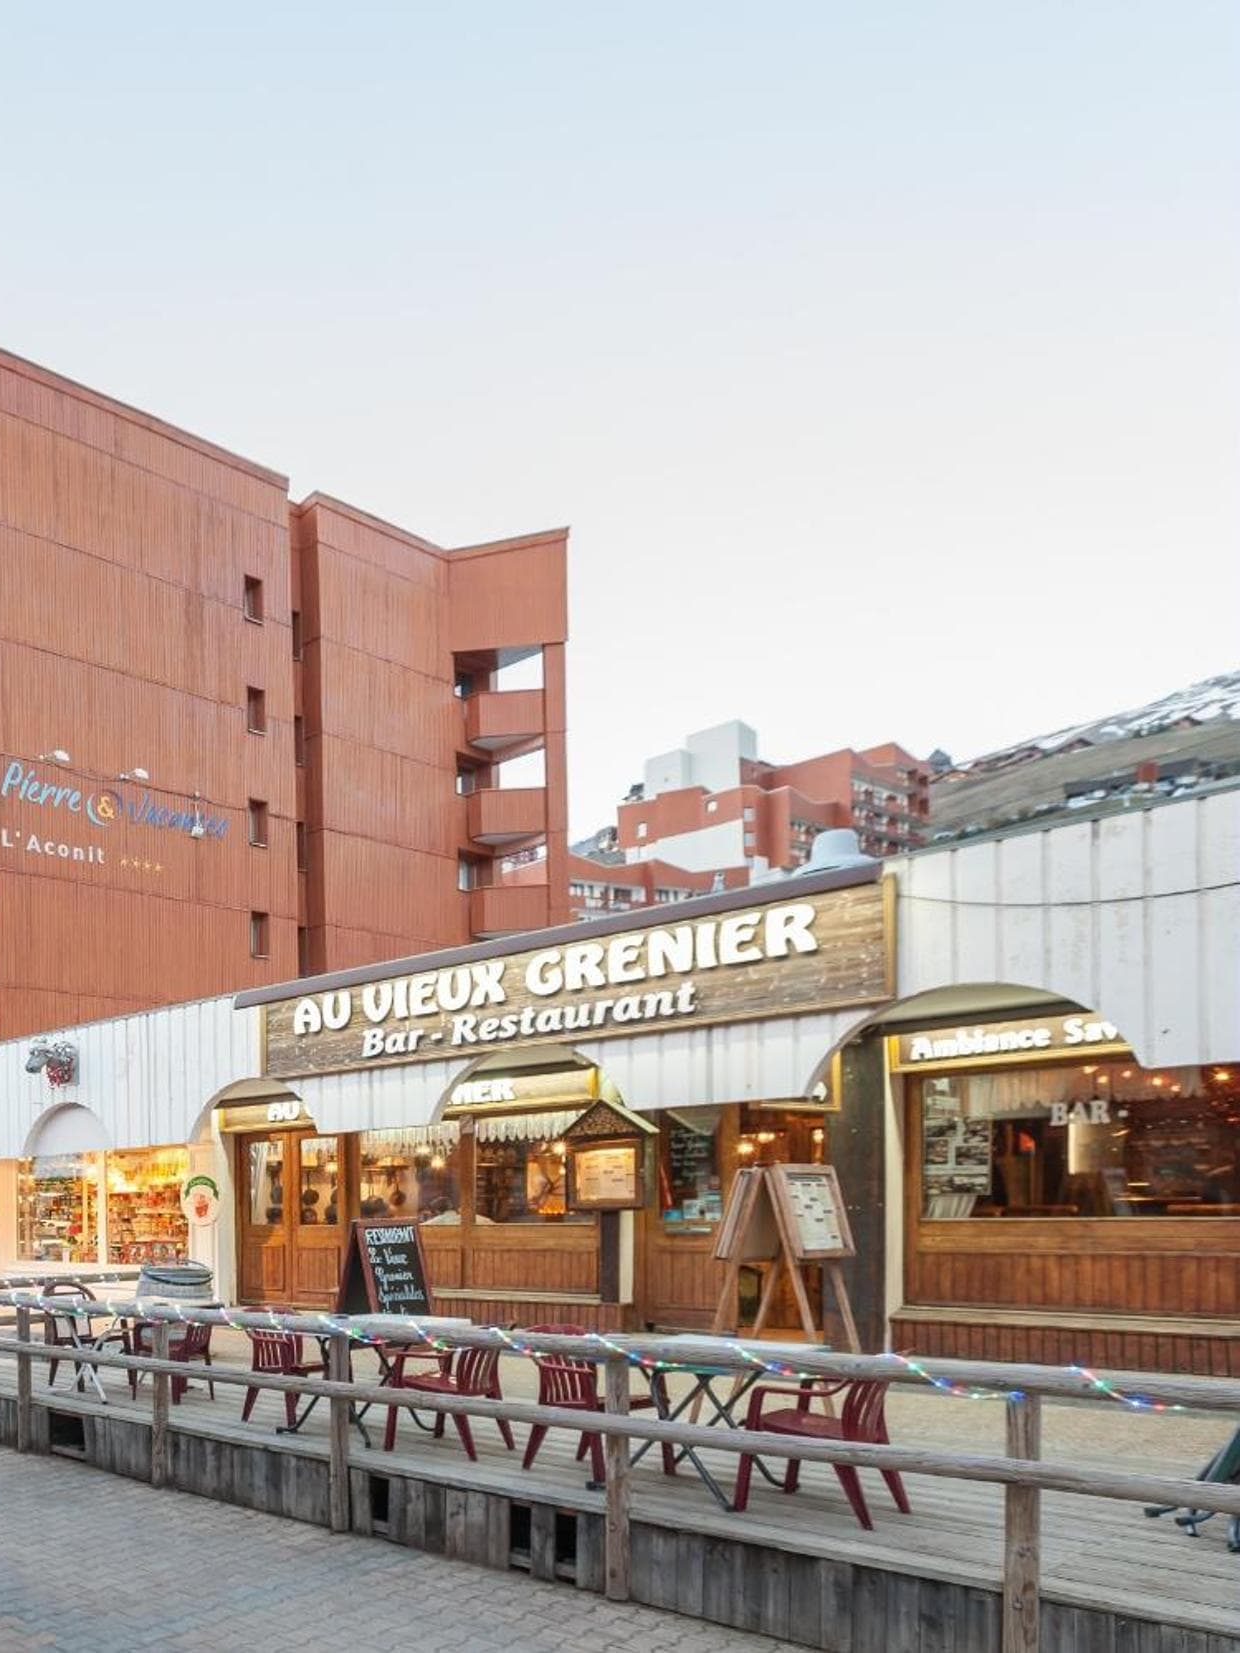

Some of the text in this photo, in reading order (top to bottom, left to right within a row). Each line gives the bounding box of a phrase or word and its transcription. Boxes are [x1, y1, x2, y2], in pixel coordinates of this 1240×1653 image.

[0, 761, 82, 812] Pierre
[293, 903, 819, 1035] AU VIEUX GRENIER
[362, 1028, 424, 1058] Bar
[451, 980, 697, 1046] Restaurant
[910, 1018, 1118, 1060] Ambiance Sav
[267, 1101, 300, 1121] AU
[1050, 1101, 1111, 1126] BAR
